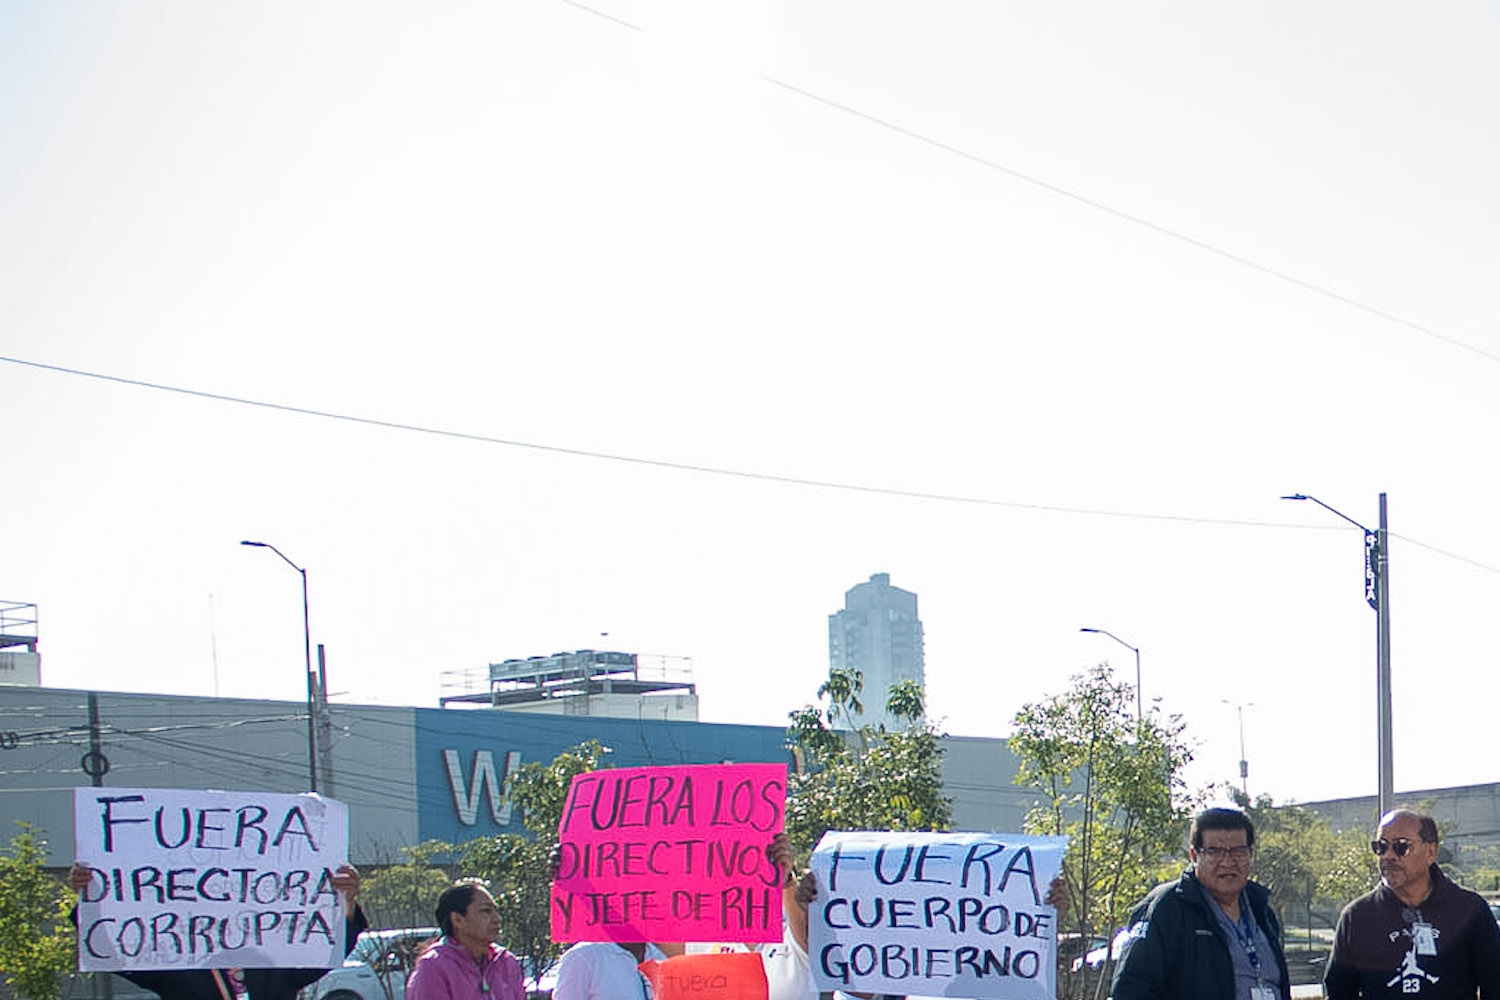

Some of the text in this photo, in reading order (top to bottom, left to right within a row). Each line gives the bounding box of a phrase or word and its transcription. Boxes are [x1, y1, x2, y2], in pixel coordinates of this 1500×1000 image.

[97, 795, 319, 854] FUERA
[562, 775, 782, 832] FUERA LOS
[81, 866, 339, 906] DIRECTORA
[556, 840, 782, 887] DIRECTIVOS
[829, 841, 1041, 906] FUERA
[555, 886, 770, 933] Y JEFE DE RH
[823, 896, 1052, 939] CUERPO DE
[84, 911, 335, 958] CORRUPTA
[1389, 928, 1440, 942] PAS
[821, 943, 1040, 984] GOBIERNO
[1402, 978, 1420, 993] 23
